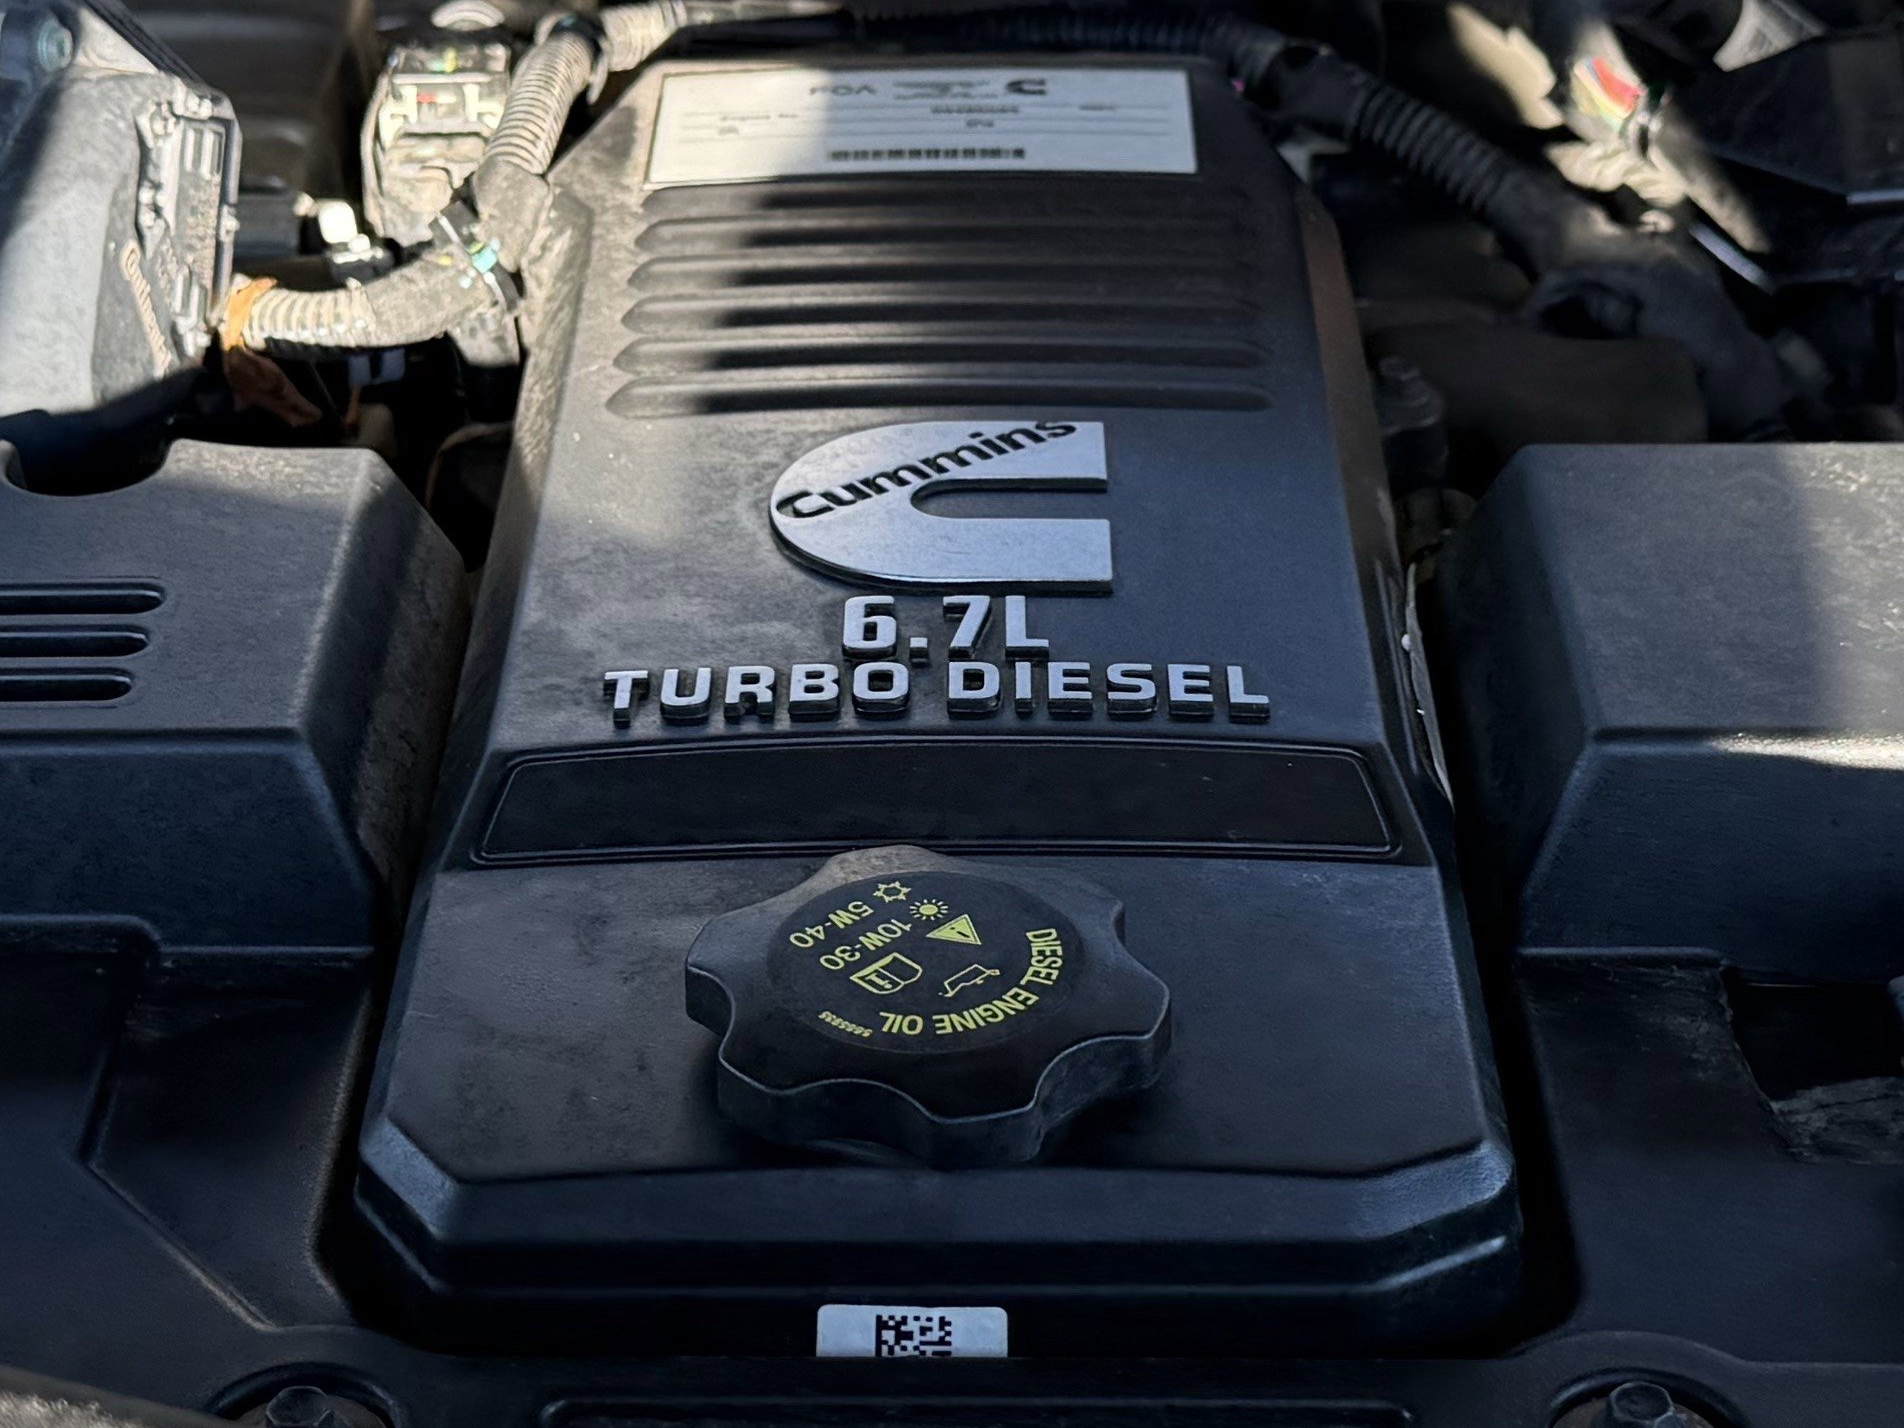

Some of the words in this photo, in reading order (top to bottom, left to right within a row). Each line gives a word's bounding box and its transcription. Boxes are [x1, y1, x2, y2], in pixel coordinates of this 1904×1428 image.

[775, 419, 1078, 519] Cummins
[842, 595, 1050, 660] 6.7L
[603, 661, 910, 726] TURBO
[946, 661, 1271, 724] DIESEL
[789, 901, 874, 948] 5W-40
[819, 919, 912, 970] 10W-30
[1020, 928, 1063, 985] DIESEL
[879, 1012, 924, 1035] OIL
[932, 987, 1039, 1034] ENGINE
